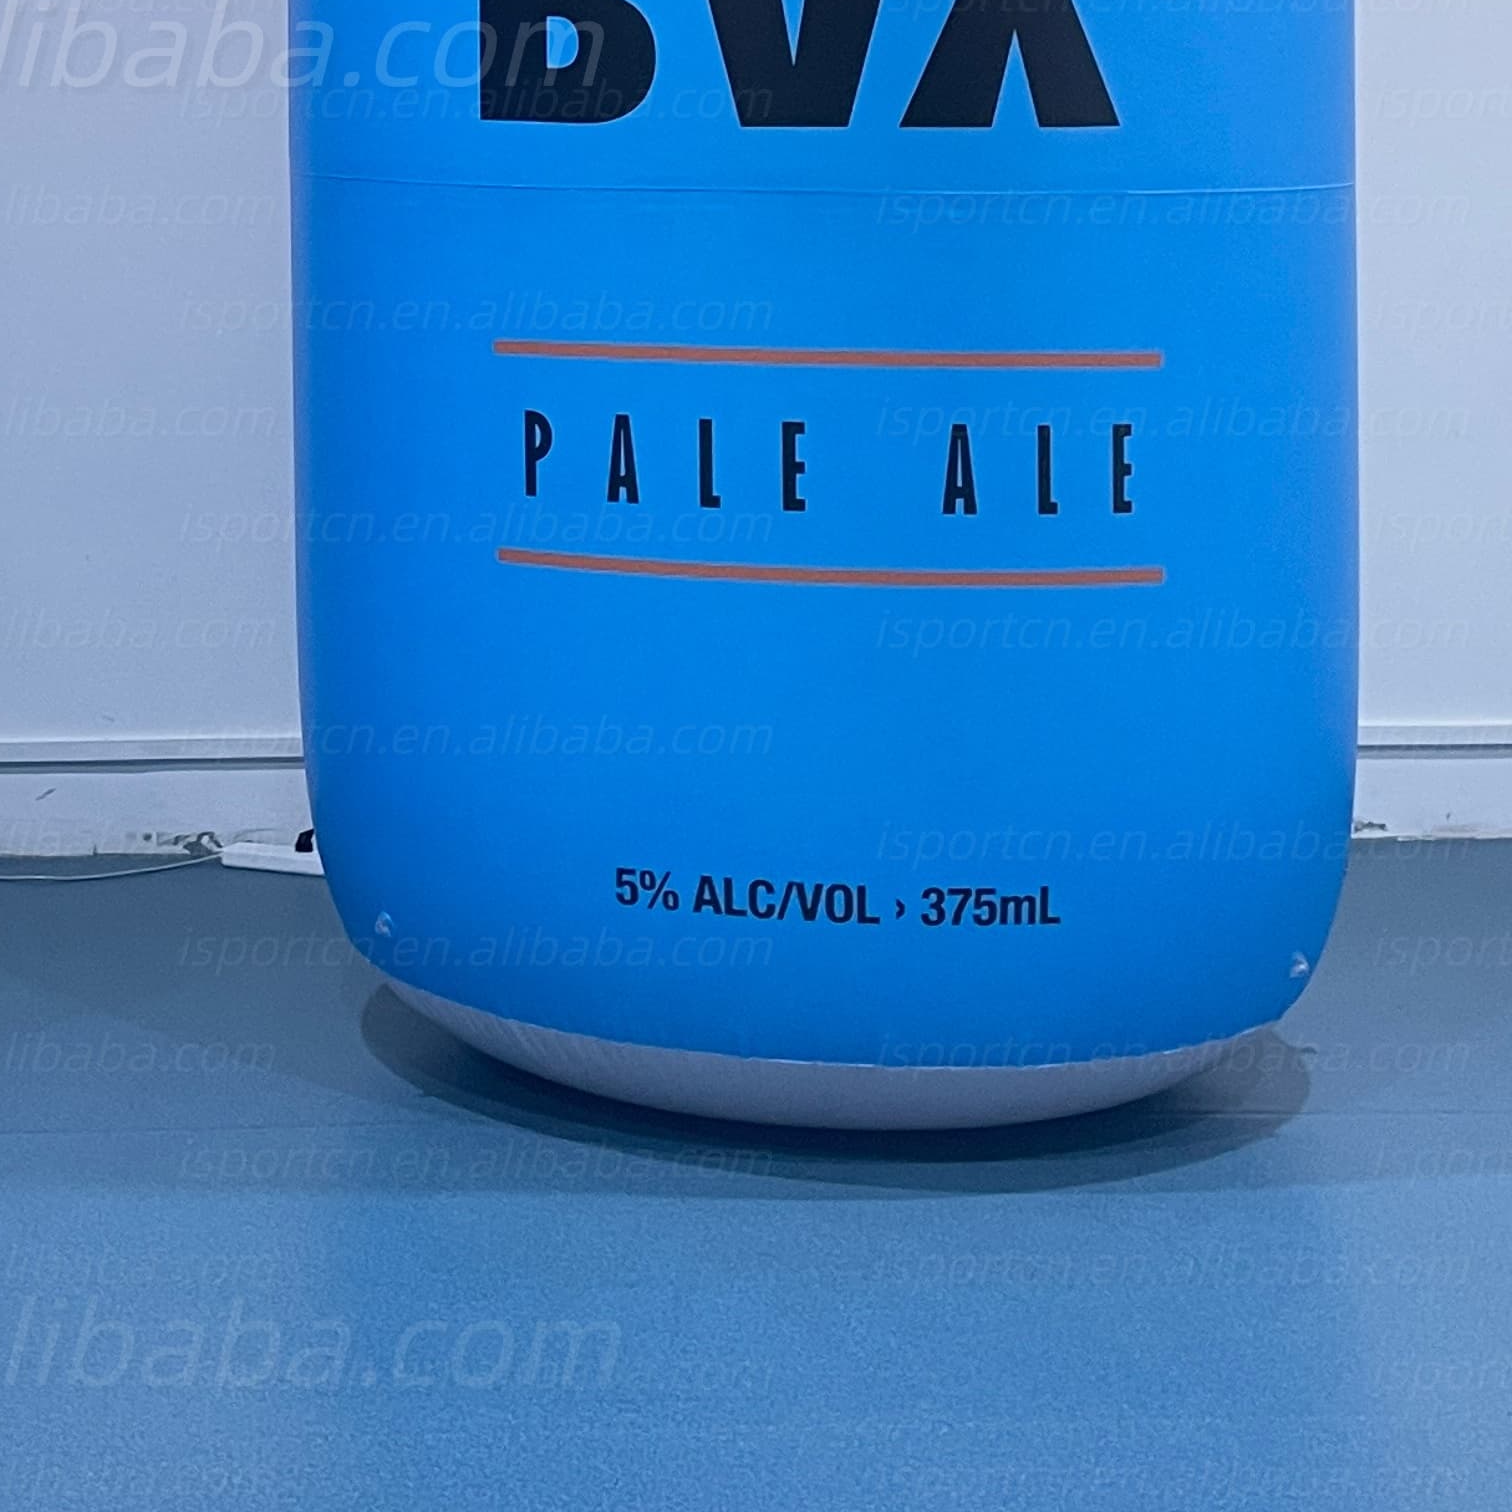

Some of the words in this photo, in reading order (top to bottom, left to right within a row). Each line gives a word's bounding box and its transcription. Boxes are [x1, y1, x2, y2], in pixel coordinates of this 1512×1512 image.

[524, 409, 806, 512] PALE
[942, 423, 1133, 516] ALE
[614, 867, 681, 912] 5%
[692, 874, 882, 926] ALC/VOL
[919, 885, 1063, 928] 375mL
